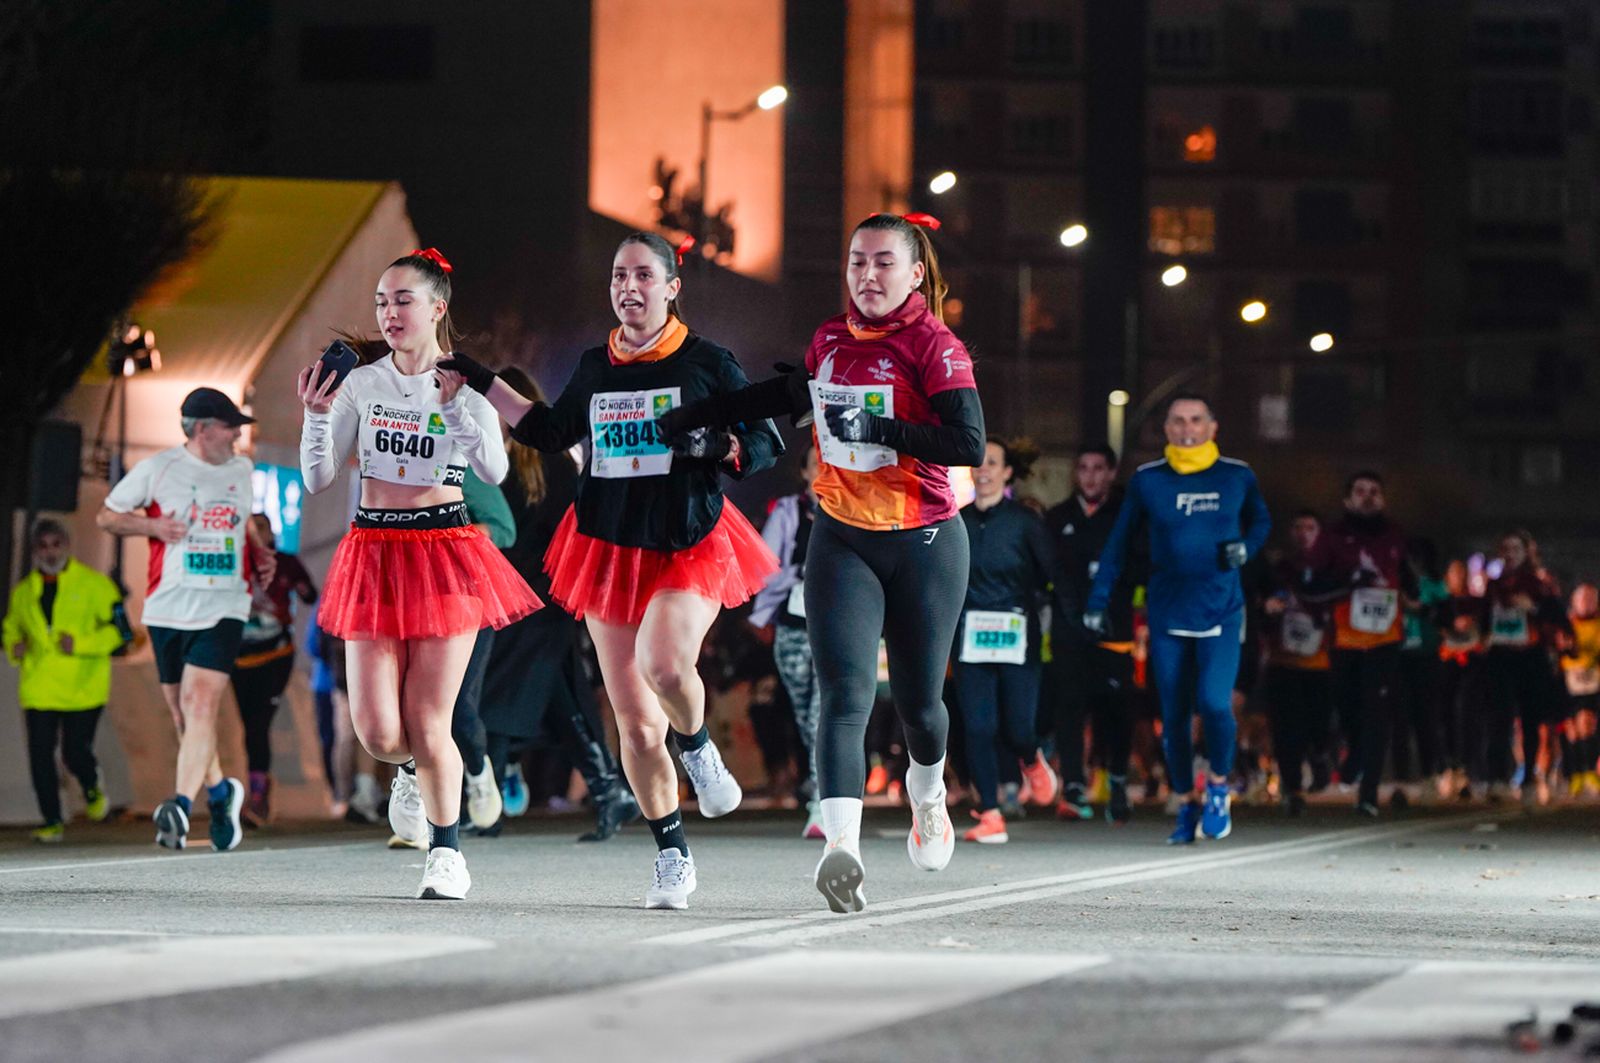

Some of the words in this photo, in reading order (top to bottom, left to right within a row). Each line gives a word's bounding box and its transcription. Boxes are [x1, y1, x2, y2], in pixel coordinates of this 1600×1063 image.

[824, 393, 847, 404] NOCHE
[608, 400, 633, 410] NOCHE
[635, 400, 646, 409] DE
[382, 410, 409, 421] NOCHE
[410, 414, 423, 423] DE
[599, 412, 615, 422] SAN
[370, 418, 388, 428] SAN
[375, 429, 435, 459] 6640
[662, 820, 680, 834] FILA
